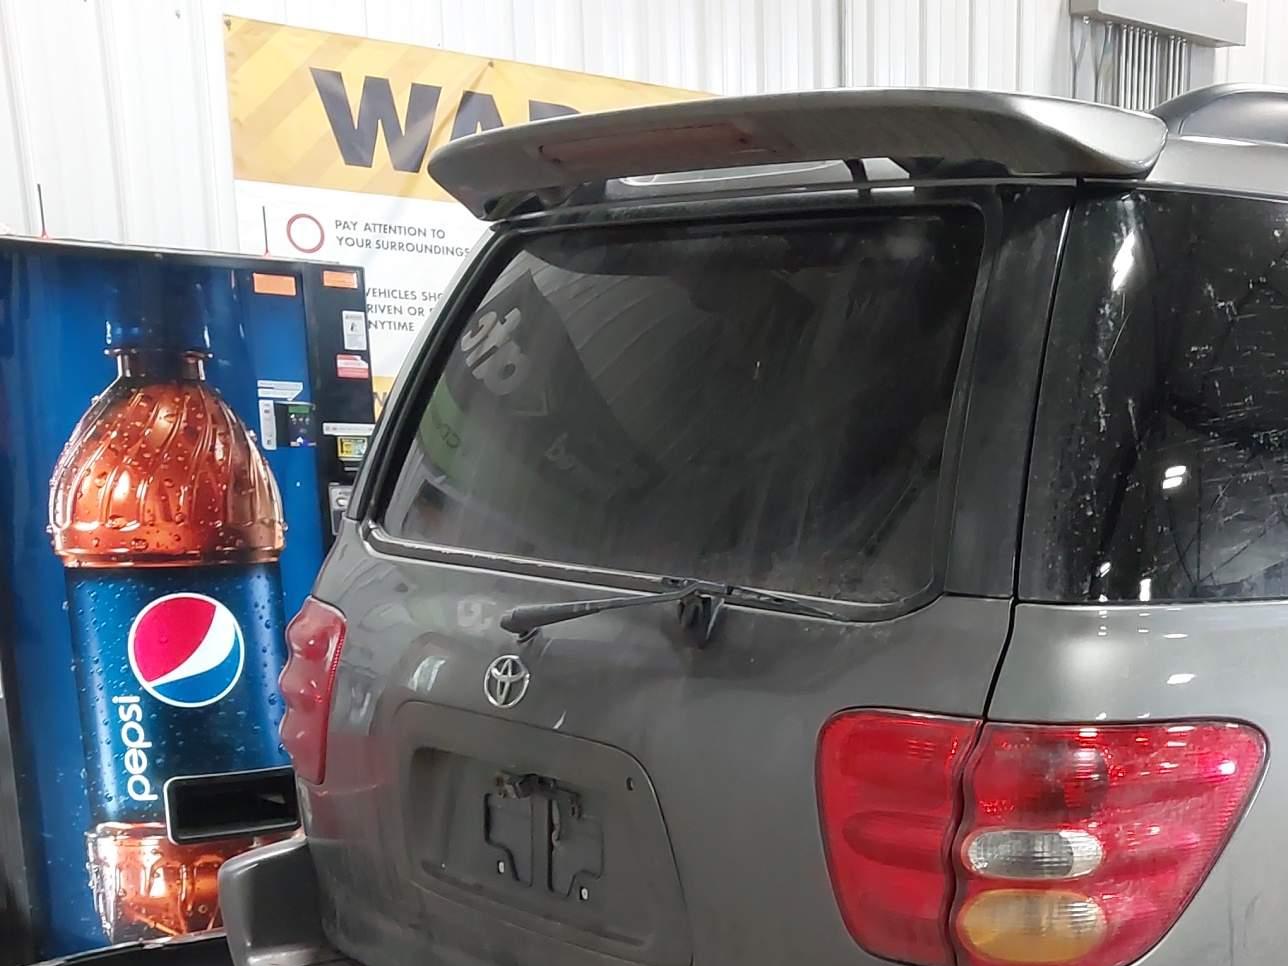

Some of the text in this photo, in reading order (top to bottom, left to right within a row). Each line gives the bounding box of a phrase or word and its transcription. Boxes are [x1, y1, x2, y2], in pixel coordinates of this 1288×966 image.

[309, 67, 581, 173] WA
[335, 219, 446, 240] PAY ATTENTION TO
[336, 235, 372, 249] YOUR
[407, 306, 425, 317] OR
[112, 695, 158, 802] pepsi
